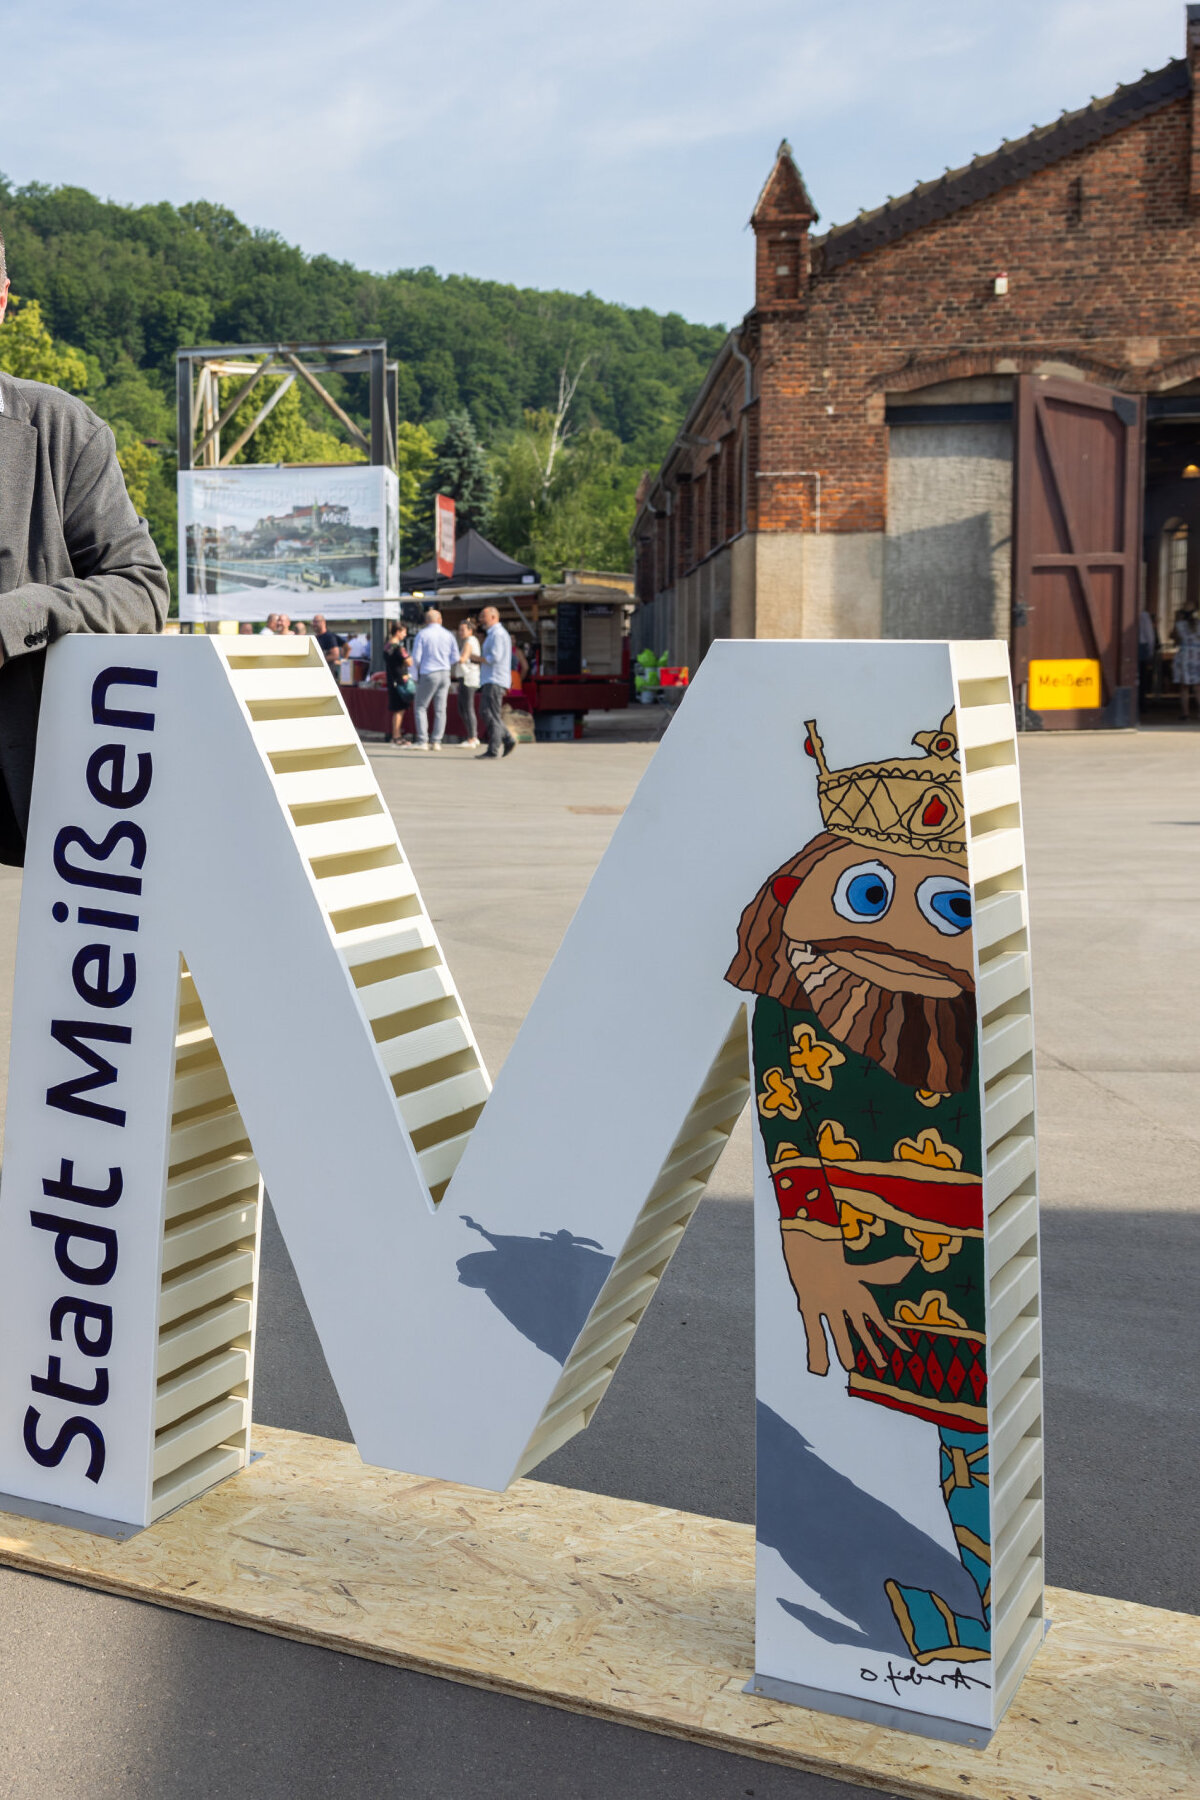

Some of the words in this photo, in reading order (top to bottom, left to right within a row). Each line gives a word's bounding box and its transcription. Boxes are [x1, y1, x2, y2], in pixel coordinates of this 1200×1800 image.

[1038, 673, 1094, 688] Meißen
[44, 665, 160, 1129] Meißen
[22, 1156, 125, 1486] Stadt
